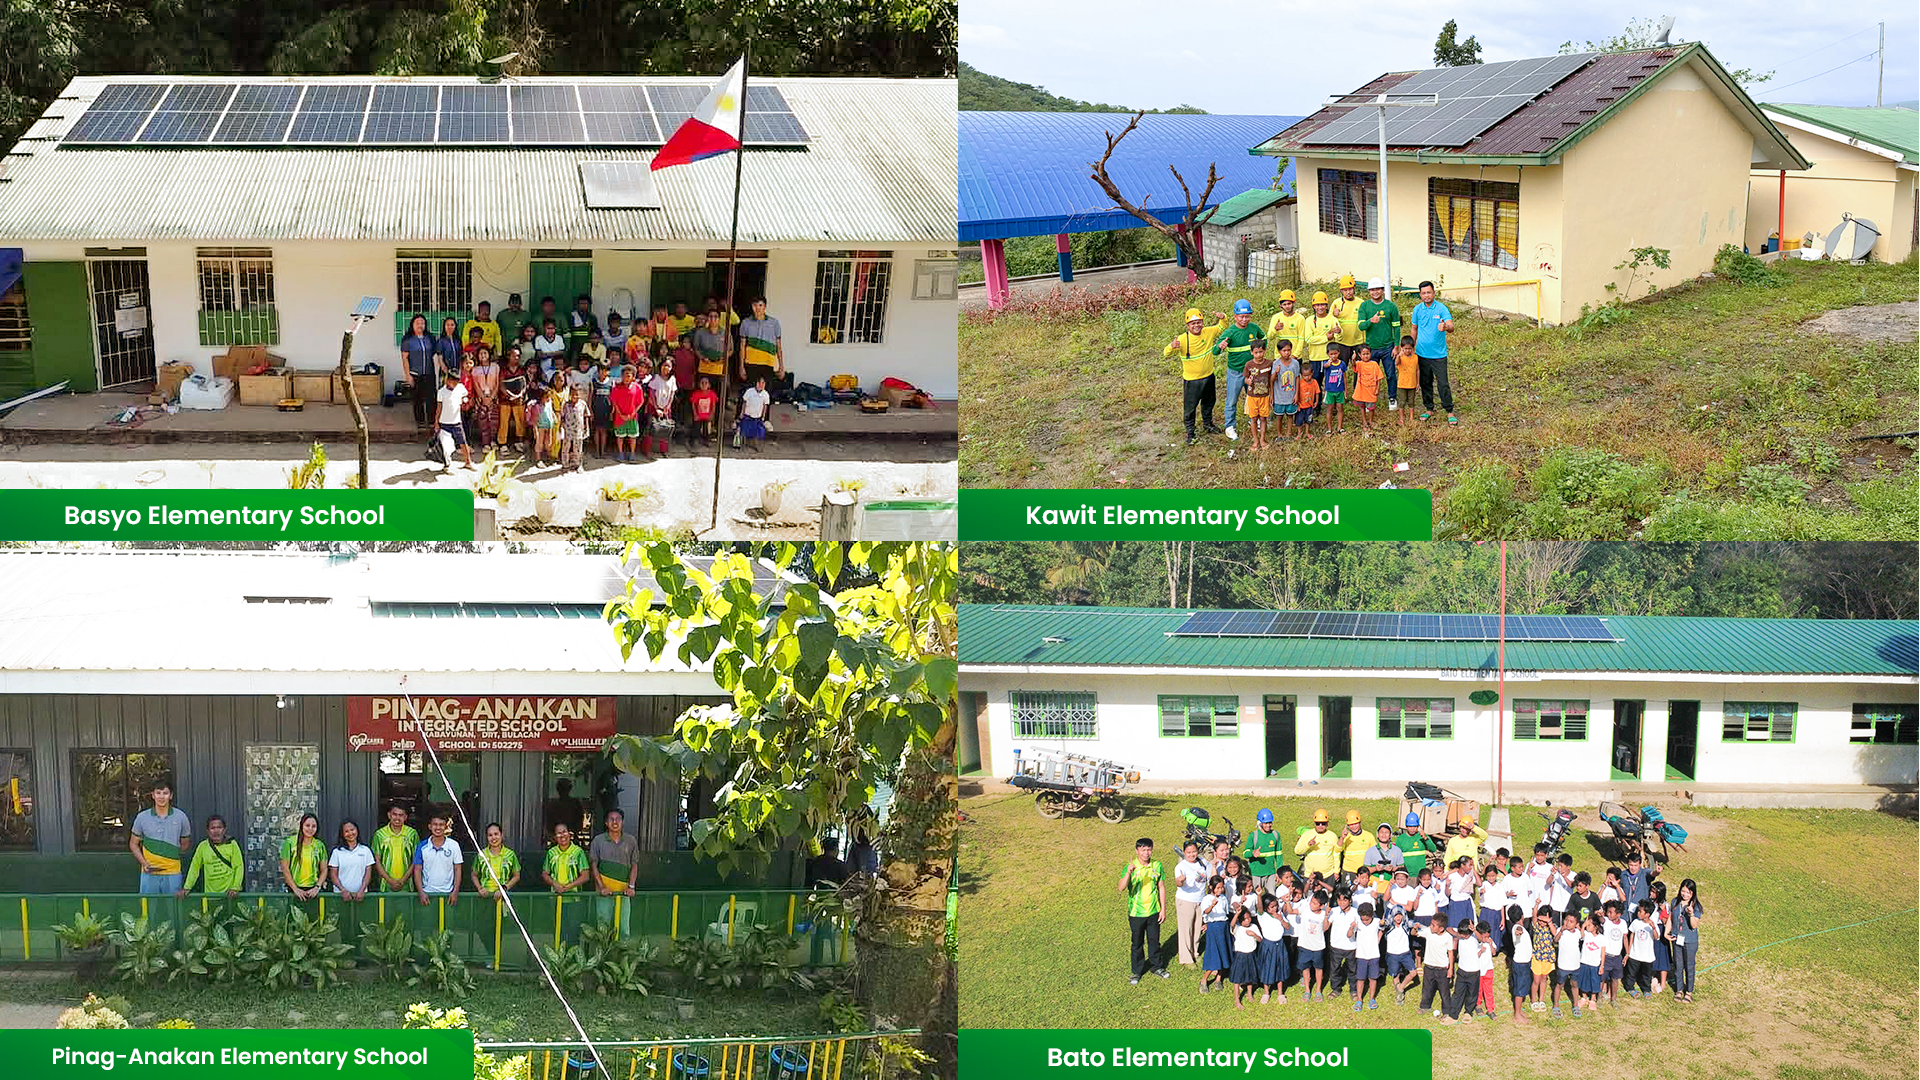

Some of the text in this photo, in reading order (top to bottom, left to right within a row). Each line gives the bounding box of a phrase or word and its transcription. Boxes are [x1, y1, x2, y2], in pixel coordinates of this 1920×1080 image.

[1511, 668, 1539, 679] SCHOOL
[372, 698, 598, 720] PINAG-ANAKAN
[501, 720, 567, 732] SCHOOL
[482, 731, 500, 739] DRT,
[439, 741, 476, 749] SCHOOL
[478, 741, 491, 749] ID:
